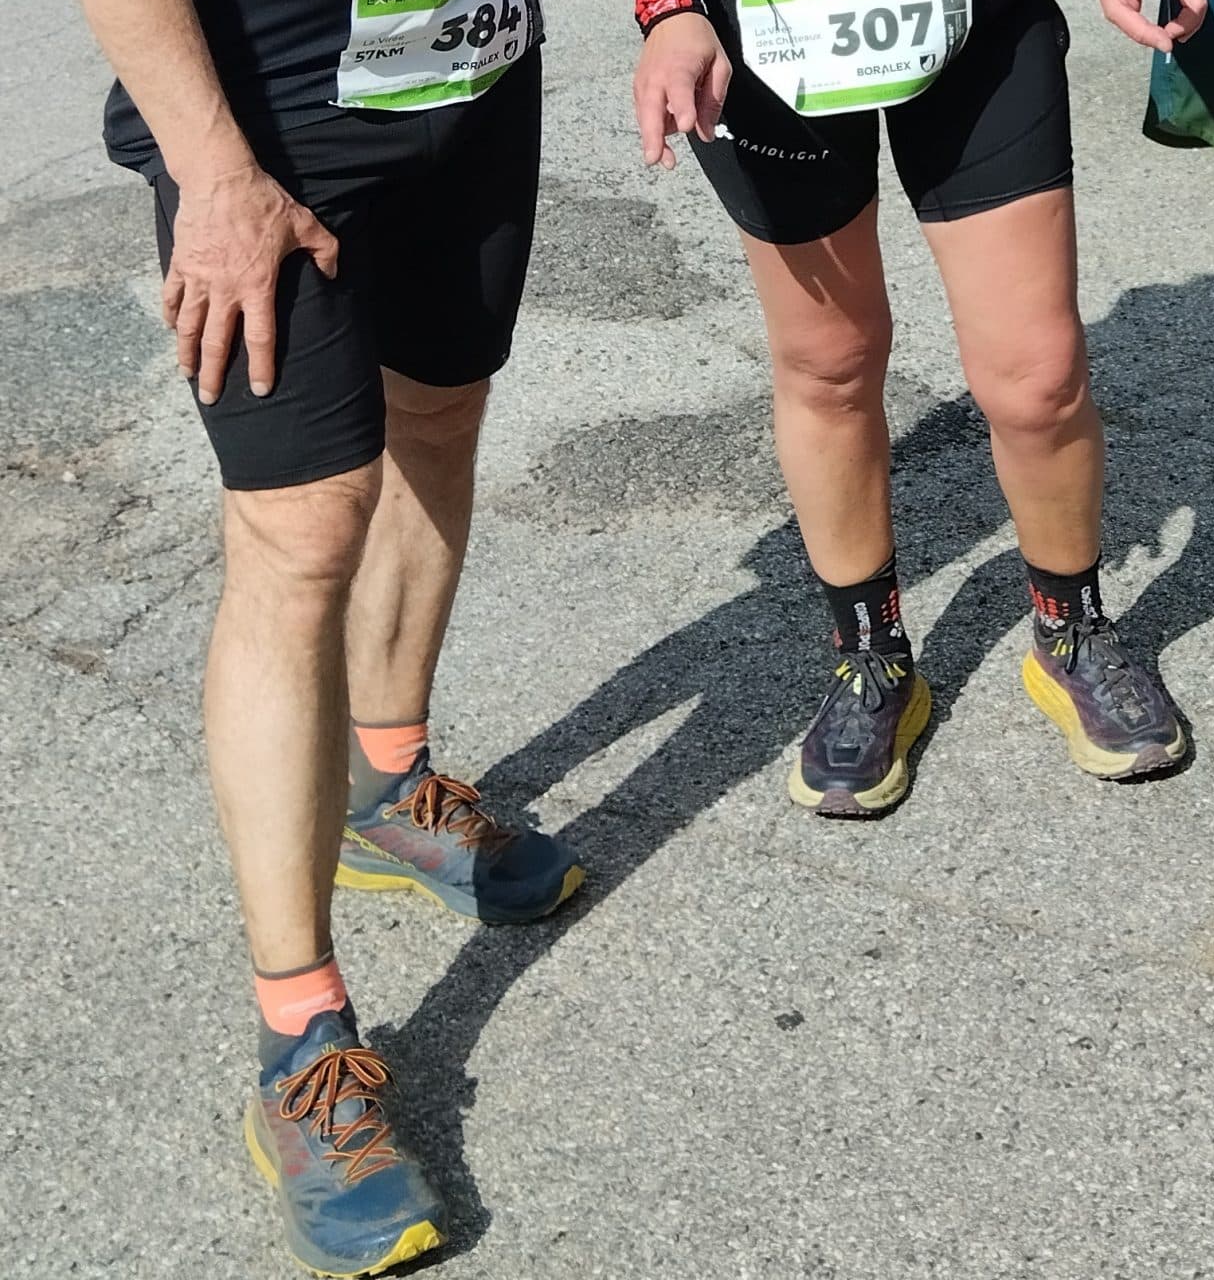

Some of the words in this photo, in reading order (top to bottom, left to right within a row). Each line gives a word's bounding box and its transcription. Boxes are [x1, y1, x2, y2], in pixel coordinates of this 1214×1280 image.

[828, 1, 933, 57] 307
[354, 46, 405, 63] 57KM
[452, 51, 500, 71] BORALEX
[758, 48, 806, 65] 57KM
[857, 61, 911, 76] BORALEX
